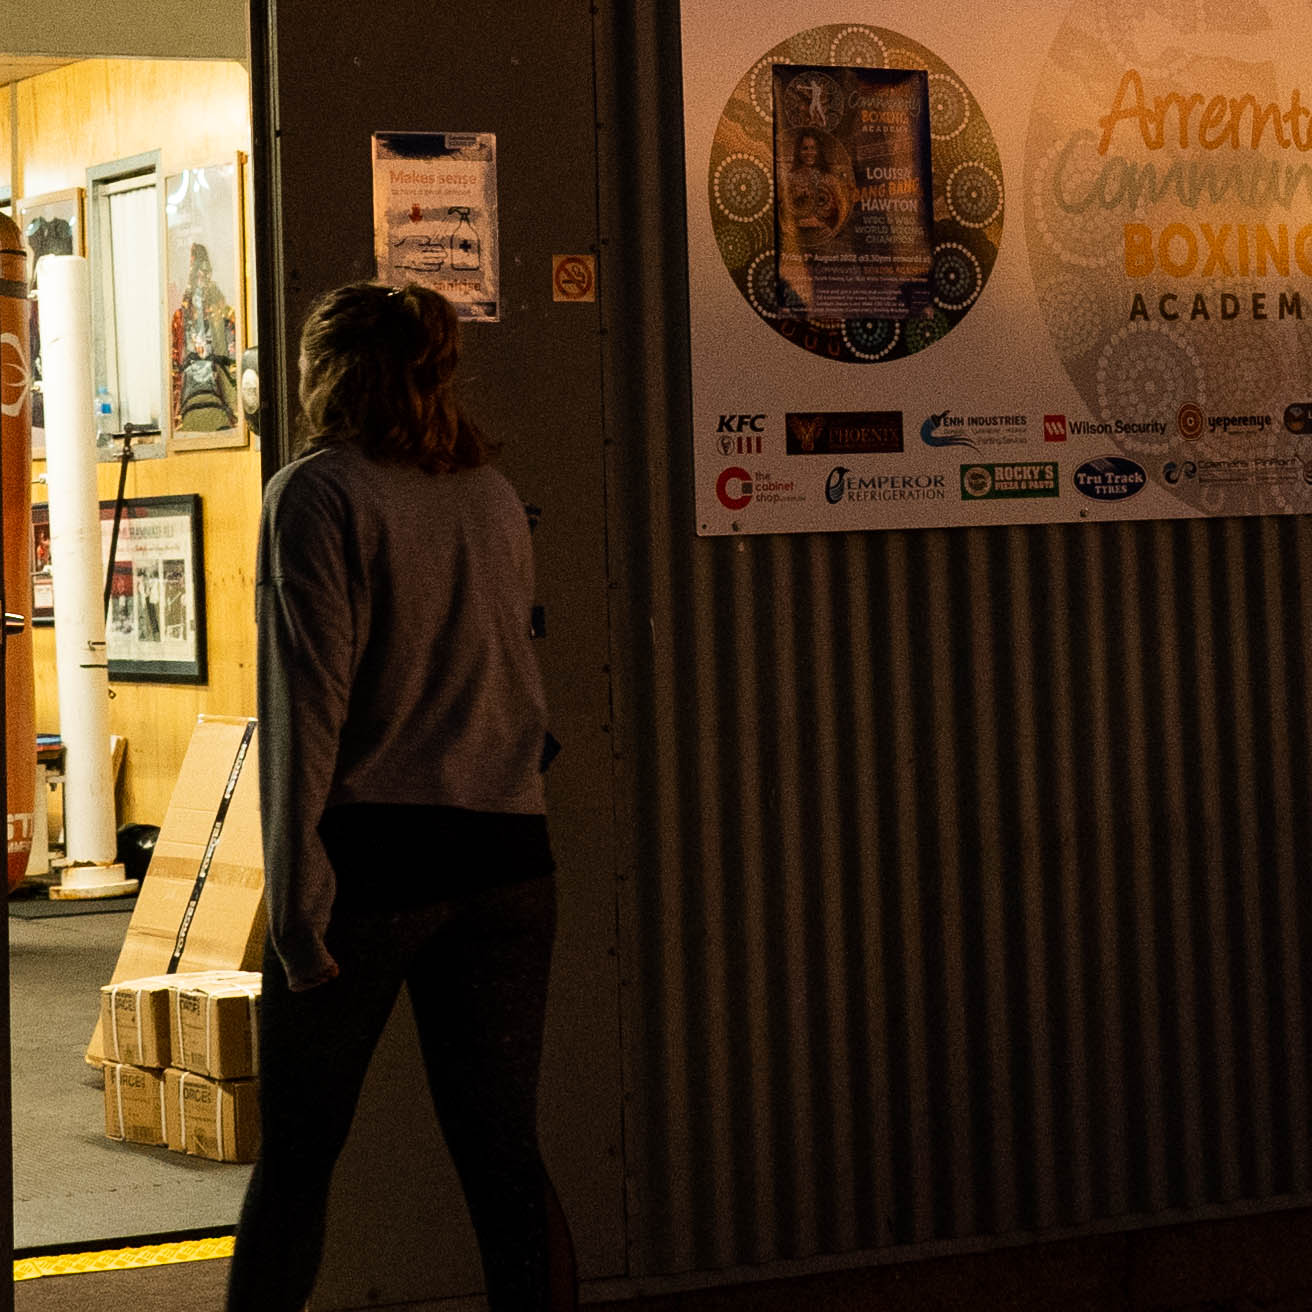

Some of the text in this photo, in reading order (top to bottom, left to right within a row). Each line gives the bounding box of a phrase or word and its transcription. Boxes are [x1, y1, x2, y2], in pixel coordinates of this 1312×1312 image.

[389, 170, 477, 187] Makes sense
[860, 198, 919, 213] HAWTON
[716, 414, 766, 433] KFC
[967, 415, 1028, 426] INDUSTRIES
[1069, 419, 1168, 436] Wilson Security
[1208, 414, 1272, 432] yeperenye
[829, 426, 899, 442] PHOENIX
[755, 470, 771, 481] the
[994, 464, 1055, 481] ROCKY'S
[1077, 471, 1144, 485] Tru Track
[755, 481, 794, 492] cabinet
[844, 474, 946, 490] EMPEROR
[1094, 484, 1128, 495] TYRES
[847, 488, 946, 502] REFRIGERATION
